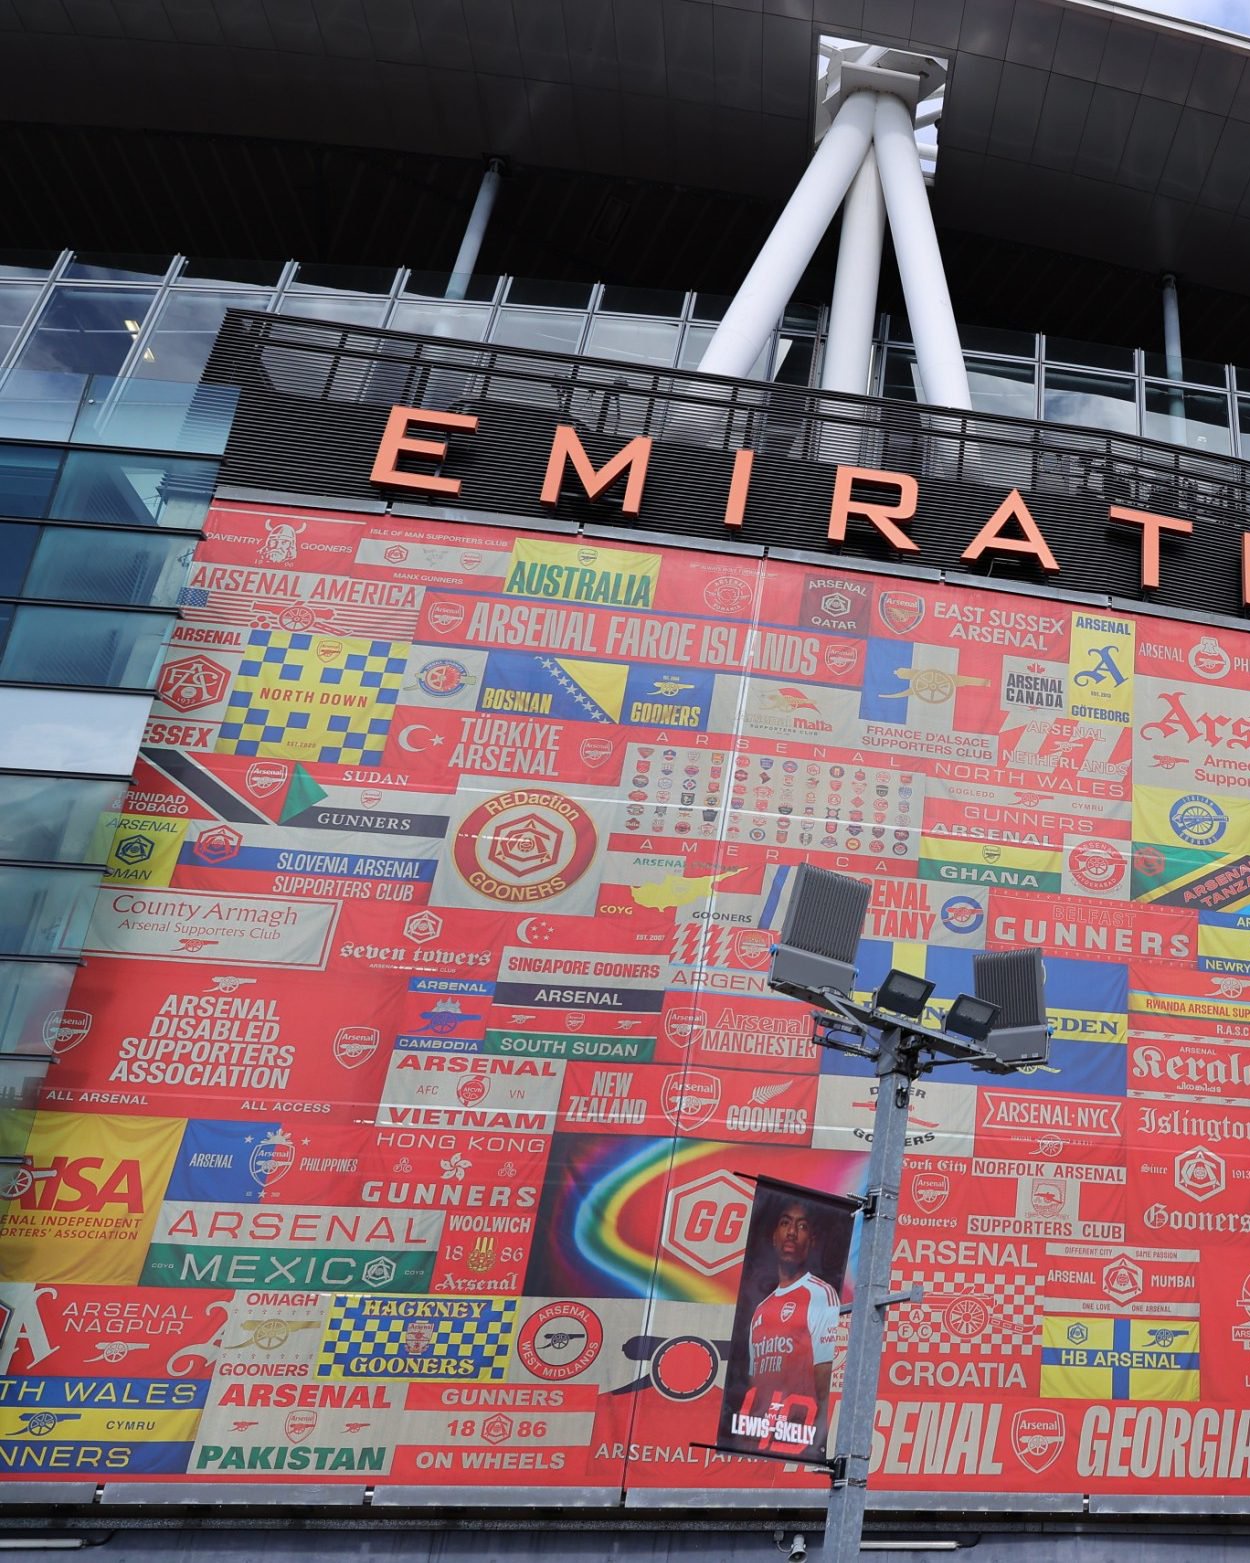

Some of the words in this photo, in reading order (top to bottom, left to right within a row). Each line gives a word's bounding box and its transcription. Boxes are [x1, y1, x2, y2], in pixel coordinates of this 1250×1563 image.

[370, 529, 390, 537] ISLE
[406, 531, 424, 539] MAN
[426, 533, 483, 545] SUPPORTERS
[485, 538, 508, 547] CLUB
[190, 570, 302, 597] ARSENAL
[310, 578, 417, 608] AMERICA
[393, 572, 416, 581] MANX
[419, 575, 463, 585] GUNNERS
[507, 561, 651, 608] AUSTRALIA
[811, 616, 856, 630] QATAR
[935, 602, 979, 623] EAST
[982, 605, 1064, 635] SUSSEX
[1077, 616, 1131, 635] ARSENAL
[172, 626, 242, 646] ARSENAL
[466, 602, 597, 652] ARSENAL
[605, 616, 695, 661] FAROE
[699, 625, 820, 676] ISLANDS
[950, 623, 1047, 651] ARSENAL
[1139, 642, 1184, 662] ARSENAL
[1007, 673, 1063, 694] ARSENAL
[260, 688, 314, 704] NORTH
[320, 691, 368, 708] DOWN
[1006, 689, 1064, 709] CANADA
[1072, 704, 1130, 723] GÖTEBORG
[461, 713, 563, 751] TÜRKİYE
[862, 736, 947, 755] SUPPORTERS
[952, 745, 992, 760] CLUB
[450, 746, 559, 776] ARSENAL
[342, 769, 409, 787] SUDAN
[936, 764, 1024, 784] NORTH
[1037, 775, 1125, 797] WALES
[276, 853, 350, 874] SLOVENIA
[353, 856, 420, 880] ARSENAL
[940, 866, 1038, 887] GHANA
[273, 876, 371, 899] SUPPORTERS
[376, 884, 414, 902] CLUB
[113, 895, 200, 921] County
[203, 902, 298, 927] Armagh
[118, 919, 170, 933] Arsenal
[175, 923, 245, 938] Supporters
[250, 929, 280, 940] Club
[509, 956, 590, 976] SINGAPORE
[593, 959, 660, 978] GOONERS
[159, 994, 280, 1021] ARSENAL
[535, 989, 623, 1005] ARSENAL
[1146, 1000, 1185, 1013] RWANDA
[1188, 1002, 1229, 1017] ARSENAL
[150, 1017, 280, 1042] DISABLED
[119, 1038, 296, 1066] SUPPORTERS
[399, 1038, 478, 1051] CAMBODIA
[500, 1038, 567, 1054] SOUTH
[573, 1041, 638, 1056] SUDAN
[109, 1061, 290, 1088] ASSOCIATION
[397, 1055, 557, 1076] ARSENAL
[591, 1072, 634, 1096] NEW
[47, 1090, 75, 1101] ALL
[79, 1092, 149, 1105] ARSENAL
[241, 1101, 269, 1111] ALL
[273, 1102, 331, 1114] ACCESS
[389, 1107, 547, 1128] VIETNAM
[565, 1097, 648, 1124] ZEALAND
[377, 1133, 456, 1150] HONG
[469, 1136, 546, 1152] KONG
[189, 1154, 233, 1168] ARSENAL
[300, 1157, 358, 1172] PHILIPPINES
[974, 1161, 1044, 1177] NORFOLK
[1054, 1164, 1124, 1183] ARSENAL
[362, 1181, 537, 1206] GUNNERS
[42, 1217, 143, 1228] INDEPENDENT
[167, 1209, 429, 1244] ARSENAL
[450, 1215, 531, 1233] WOOLWICH
[970, 1217, 1073, 1237] SUPPORTERS
[1083, 1224, 1122, 1239] CLUB
[892, 1243, 1038, 1267] ARSENAL
[247, 1293, 319, 1307] OMAGH
[362, 1300, 486, 1320] HACKNEY
[63, 1303, 194, 1319] ARSENAL
[65, 1320, 183, 1335] NAGPUR
[1061, 1350, 1087, 1366] HB
[1095, 1351, 1181, 1368] ARSENAL
[219, 1364, 309, 1377] GOONERS
[889, 1362, 1027, 1388] CROATIA
[219, 1384, 391, 1408] ARSENAL
[442, 1388, 565, 1406] GUNNERS
[106, 1420, 155, 1431] CYMRU
[732, 1414, 816, 1445] LEWIS-SKELLY
[197, 1446, 385, 1471] PAKISTAN
[416, 1452, 461, 1469] ON
[462, 1453, 565, 1469] WHEELS
